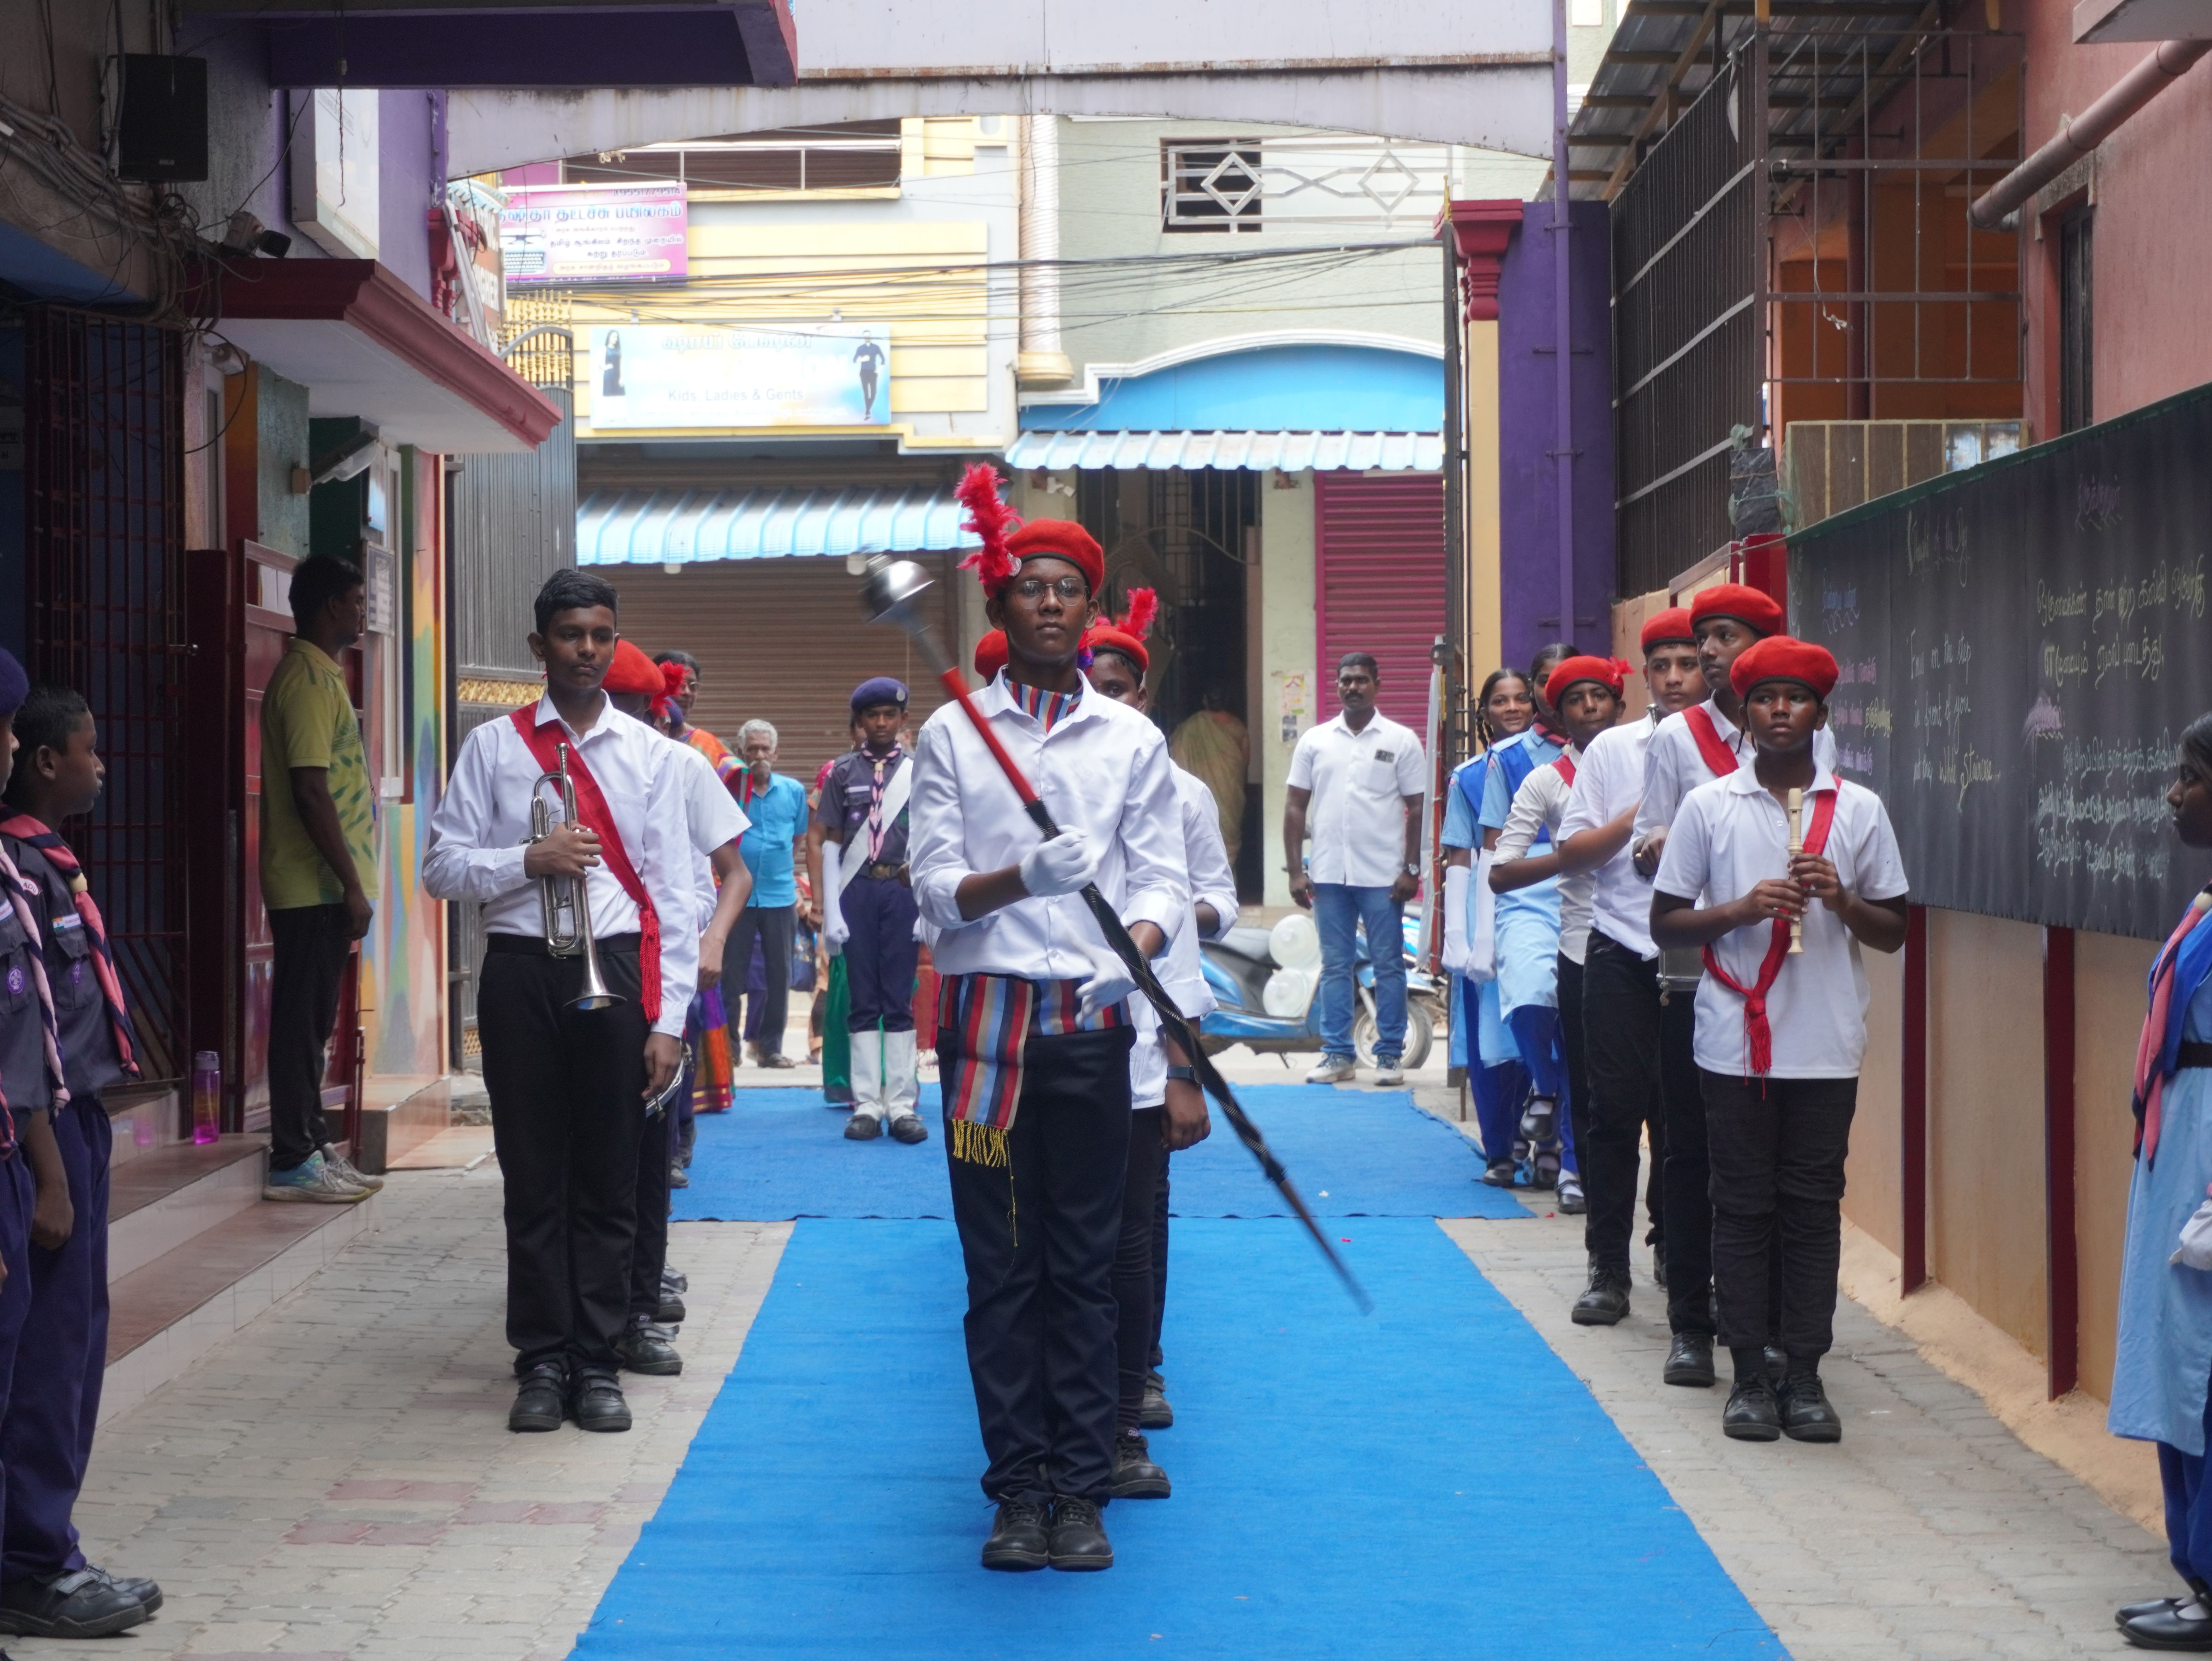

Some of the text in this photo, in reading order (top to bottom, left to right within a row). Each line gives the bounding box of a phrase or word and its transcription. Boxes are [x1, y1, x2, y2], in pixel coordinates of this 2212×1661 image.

[555, 204, 609, 223] தட்டச்சு
[616, 201, 682, 219] பயிலகம்
[705, 389, 748, 402] Ladies
[752, 388, 761, 401] &
[766, 387, 804, 401] Gents
[23, 882, 37, 893] ADU
